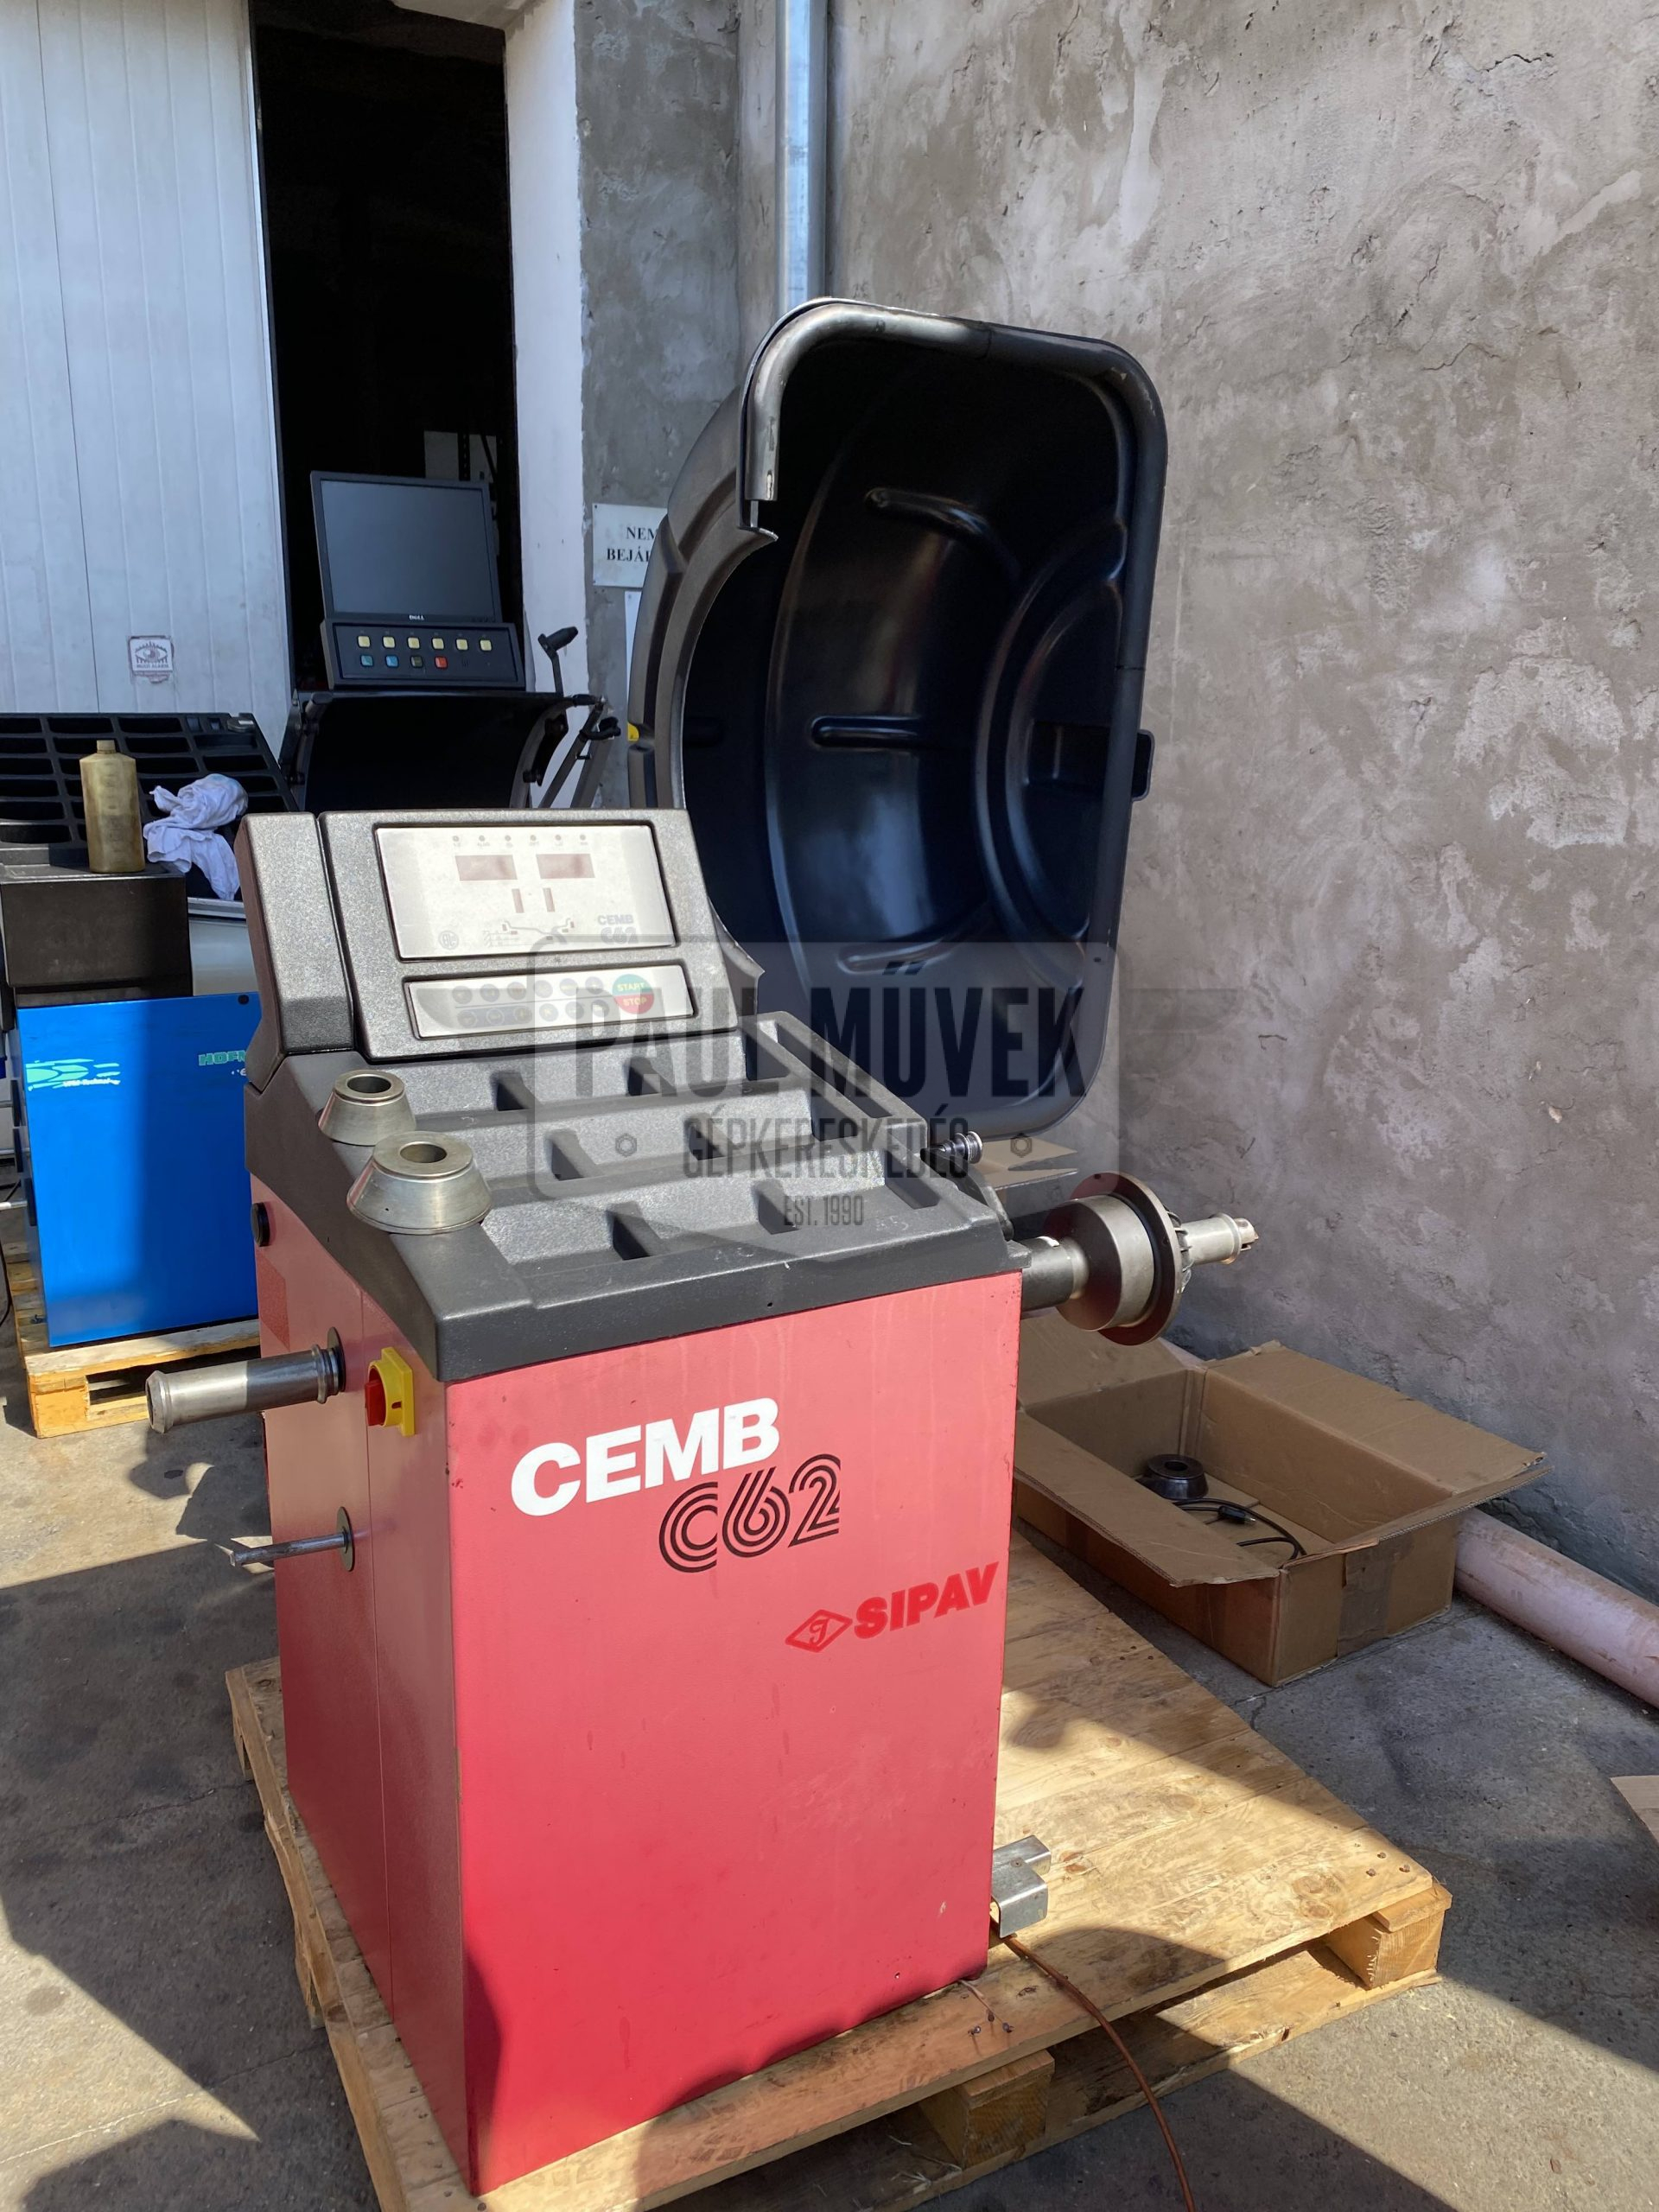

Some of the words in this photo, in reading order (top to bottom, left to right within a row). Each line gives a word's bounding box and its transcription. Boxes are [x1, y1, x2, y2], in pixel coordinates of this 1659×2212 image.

[597, 914, 634, 925] CEMB
[601, 926, 639, 944] C62
[617, 982, 645, 992] START
[622, 996, 647, 1006] STOP
[511, 1397, 779, 1516] CEMB
[659, 1453, 841, 1573] C62
[854, 1561, 1000, 1640] SIPAV
